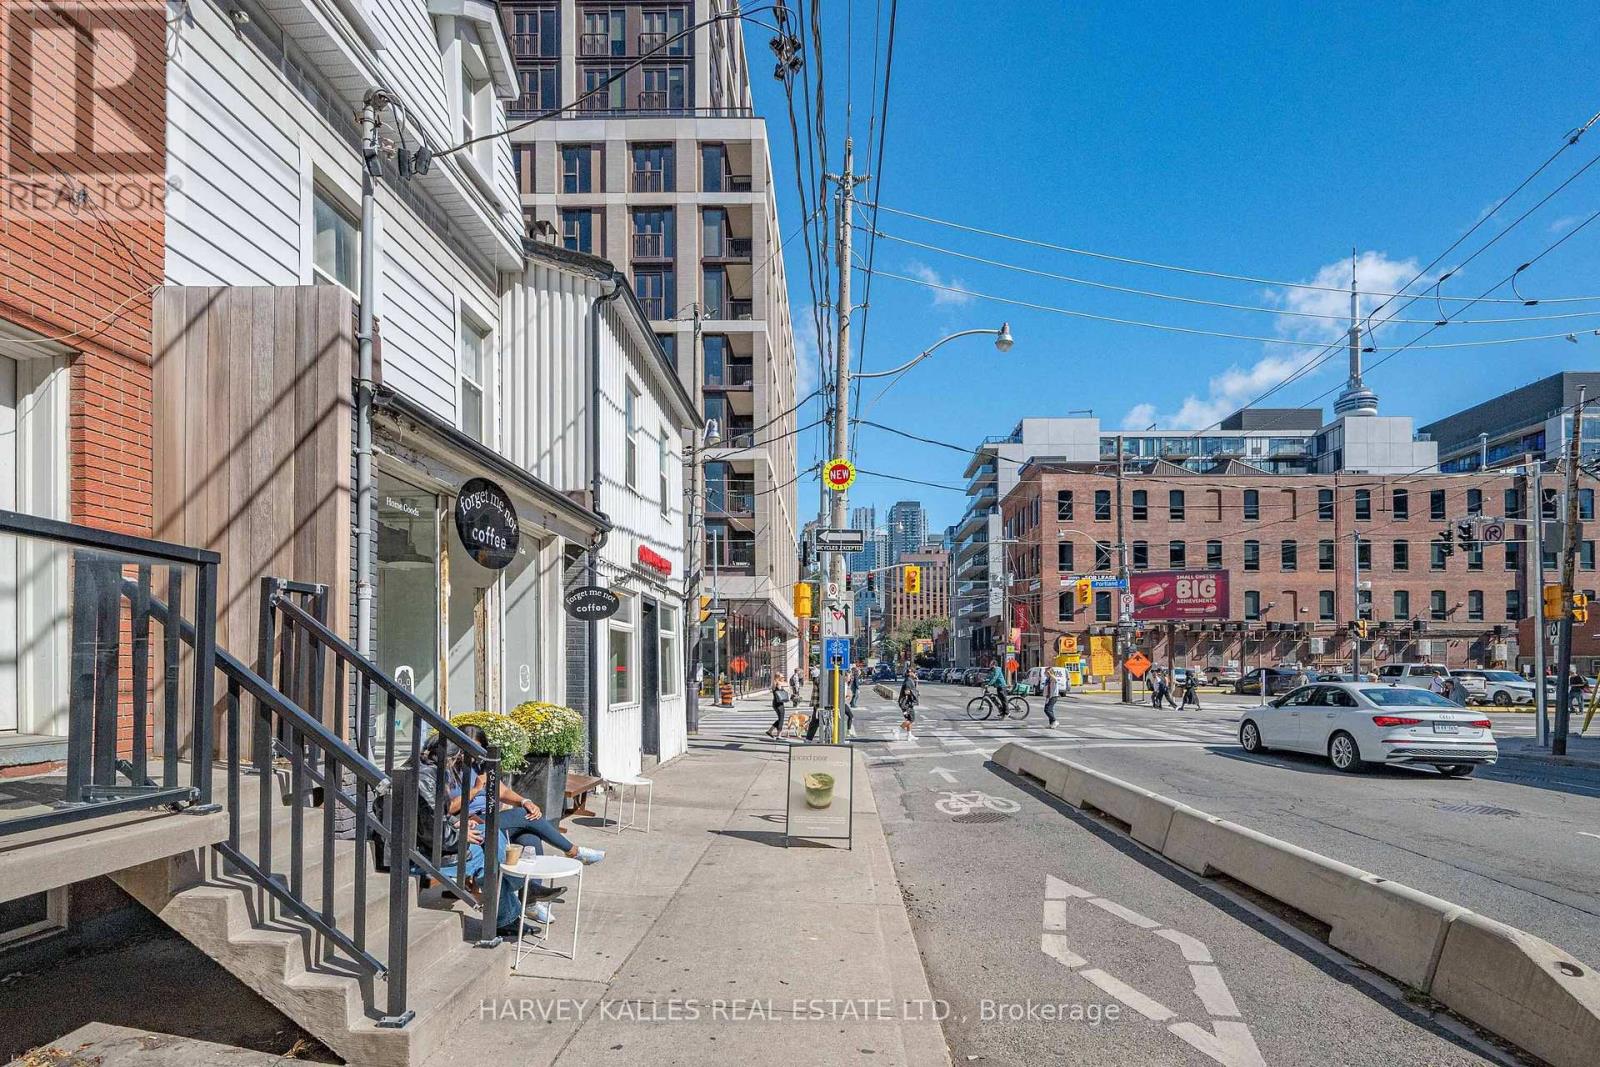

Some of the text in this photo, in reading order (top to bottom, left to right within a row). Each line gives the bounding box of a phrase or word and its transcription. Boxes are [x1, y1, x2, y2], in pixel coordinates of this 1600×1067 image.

[830, 469, 848, 480] NEW
[386, 496, 420, 517] Home Goods
[460, 489, 518, 535] forget me not
[472, 526, 507, 550] coffee
[566, 591, 588, 605] forget
[603, 592, 616, 603] not
[1176, 580, 1216, 598] BIG
[577, 604, 608, 613] coffee
